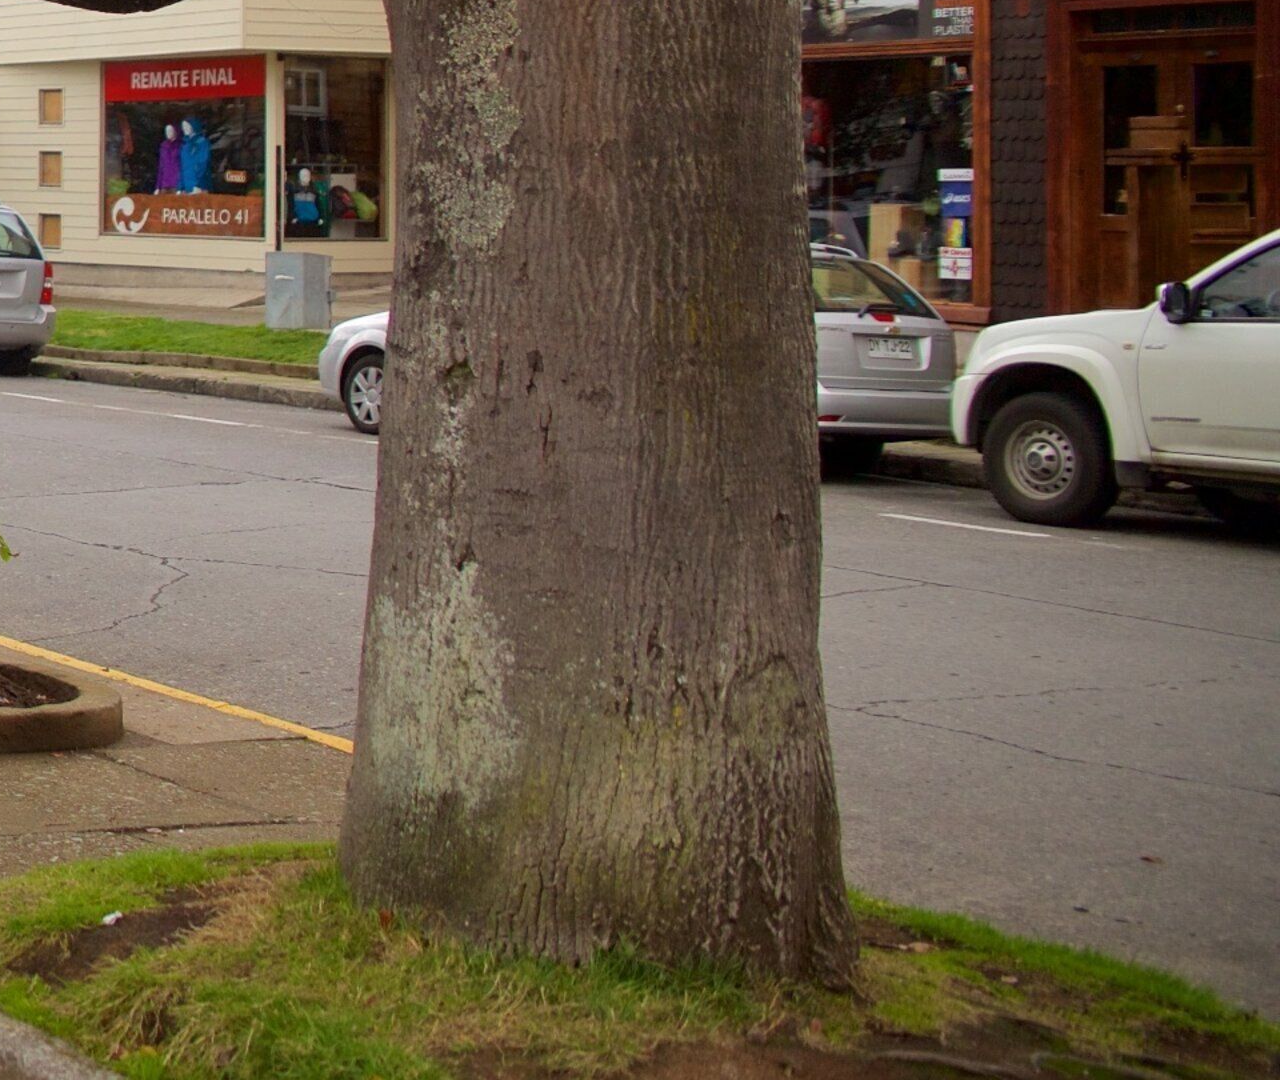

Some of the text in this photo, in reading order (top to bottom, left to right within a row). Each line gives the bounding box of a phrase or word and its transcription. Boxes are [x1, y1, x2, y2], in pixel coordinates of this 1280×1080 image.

[934, 7, 974, 18] BETTER
[130, 68, 236, 89] REMATE FINAL
[162, 208, 249, 225] PARALELO 41
